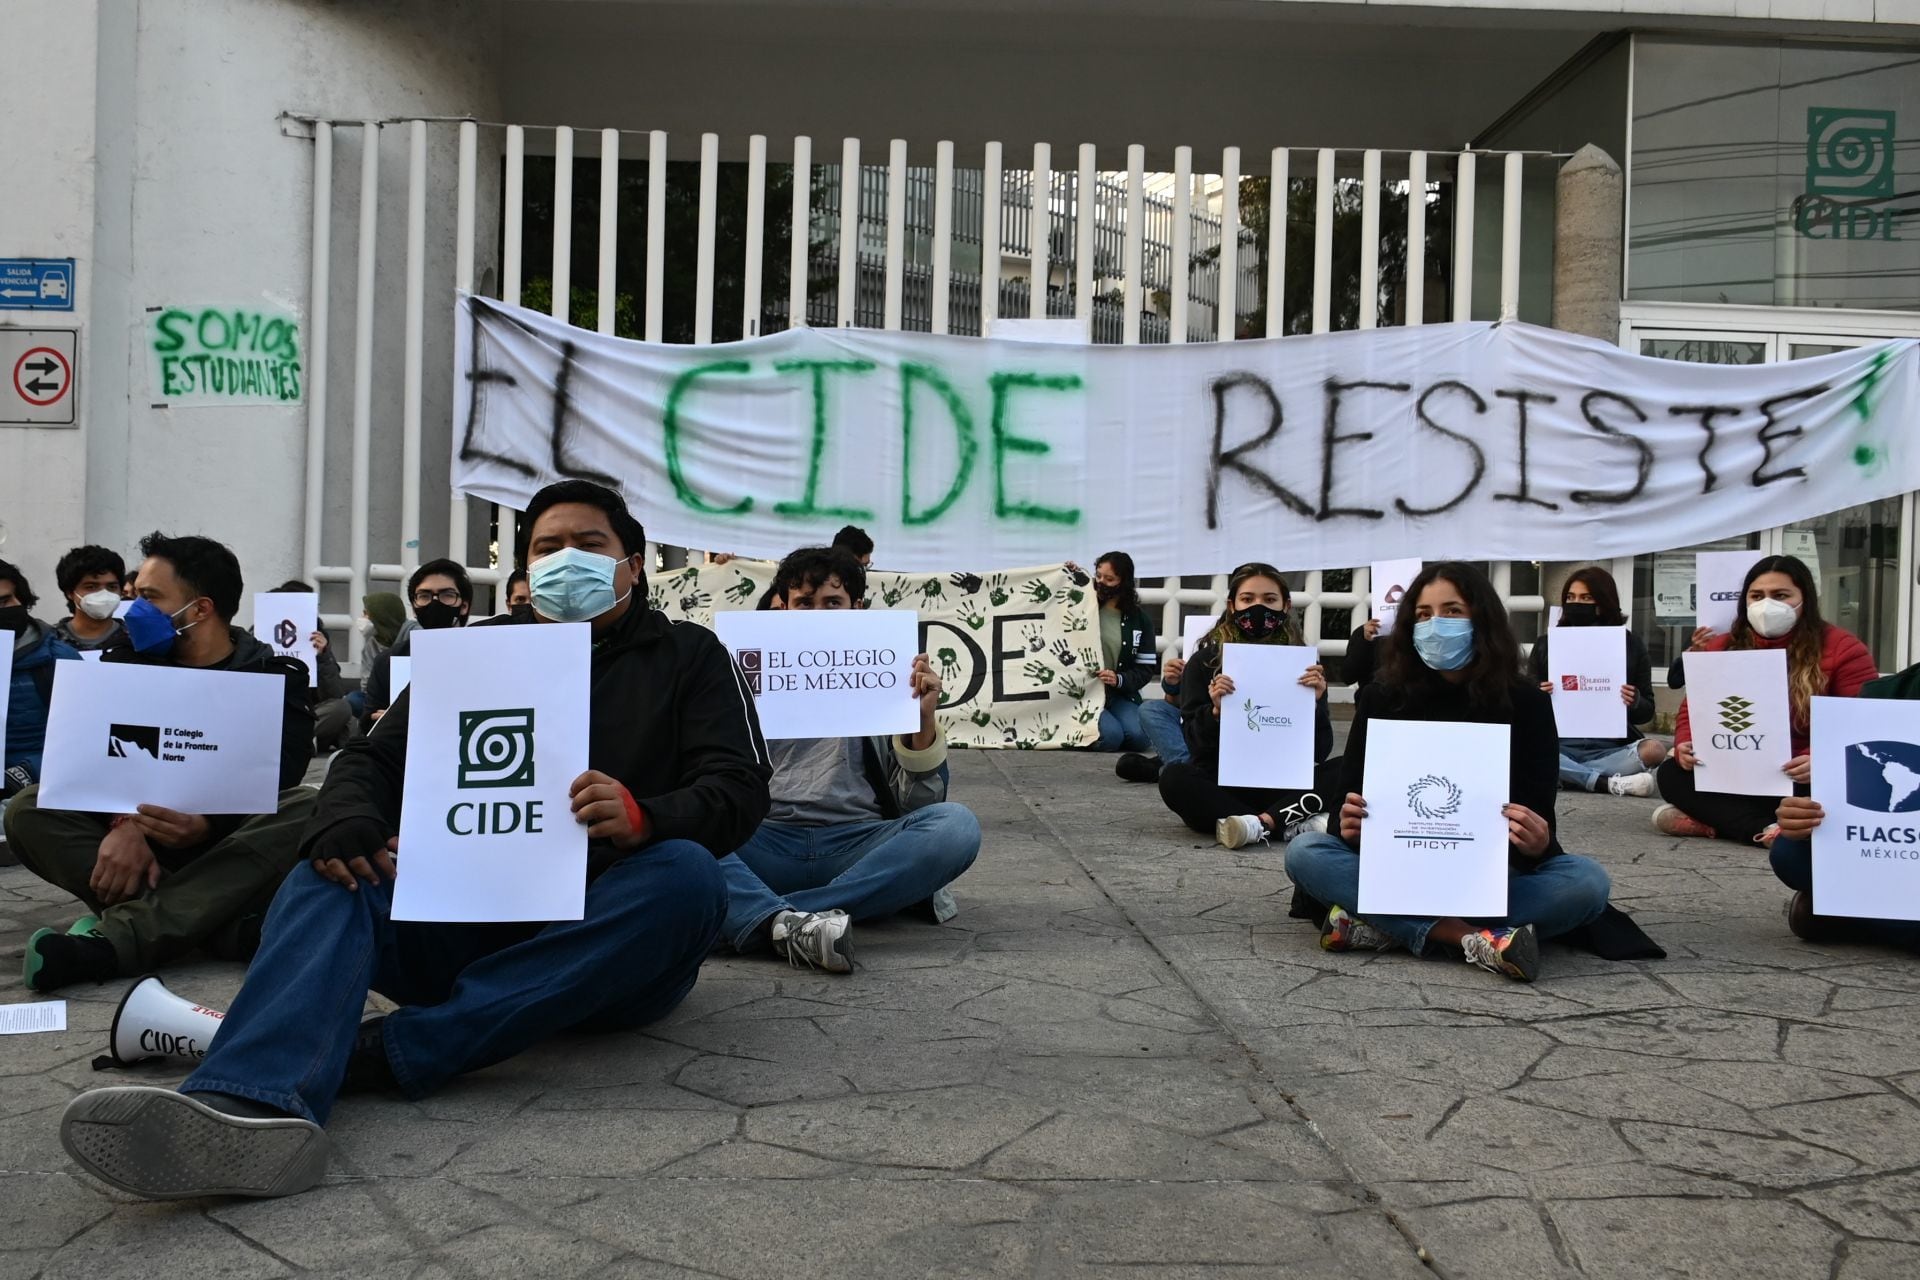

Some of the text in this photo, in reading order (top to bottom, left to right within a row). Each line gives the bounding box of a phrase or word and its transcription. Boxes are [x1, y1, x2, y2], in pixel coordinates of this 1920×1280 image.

[1799, 202, 1904, 241] CIDE
[154, 309, 299, 361] SOMOS
[162, 353, 302, 401] ESTUDIANTES
[460, 296, 621, 489] EL
[662, 360, 1083, 525] CIDE
[768, 648, 896, 669] EL COLEGIO
[918, 612, 1050, 711] DE
[768, 668, 897, 692] DE MÉXICO
[164, 727, 204, 740] El Colegio
[1711, 733, 1766, 751] CICY
[163, 740, 218, 751] de la Frontera
[162, 753, 186, 762] Norte
[446, 800, 544, 836] CIDE
[1846, 824, 1920, 844] FLACS
[1407, 840, 1460, 850] IPICYT
[1860, 847, 1920, 860] MÉXICO
